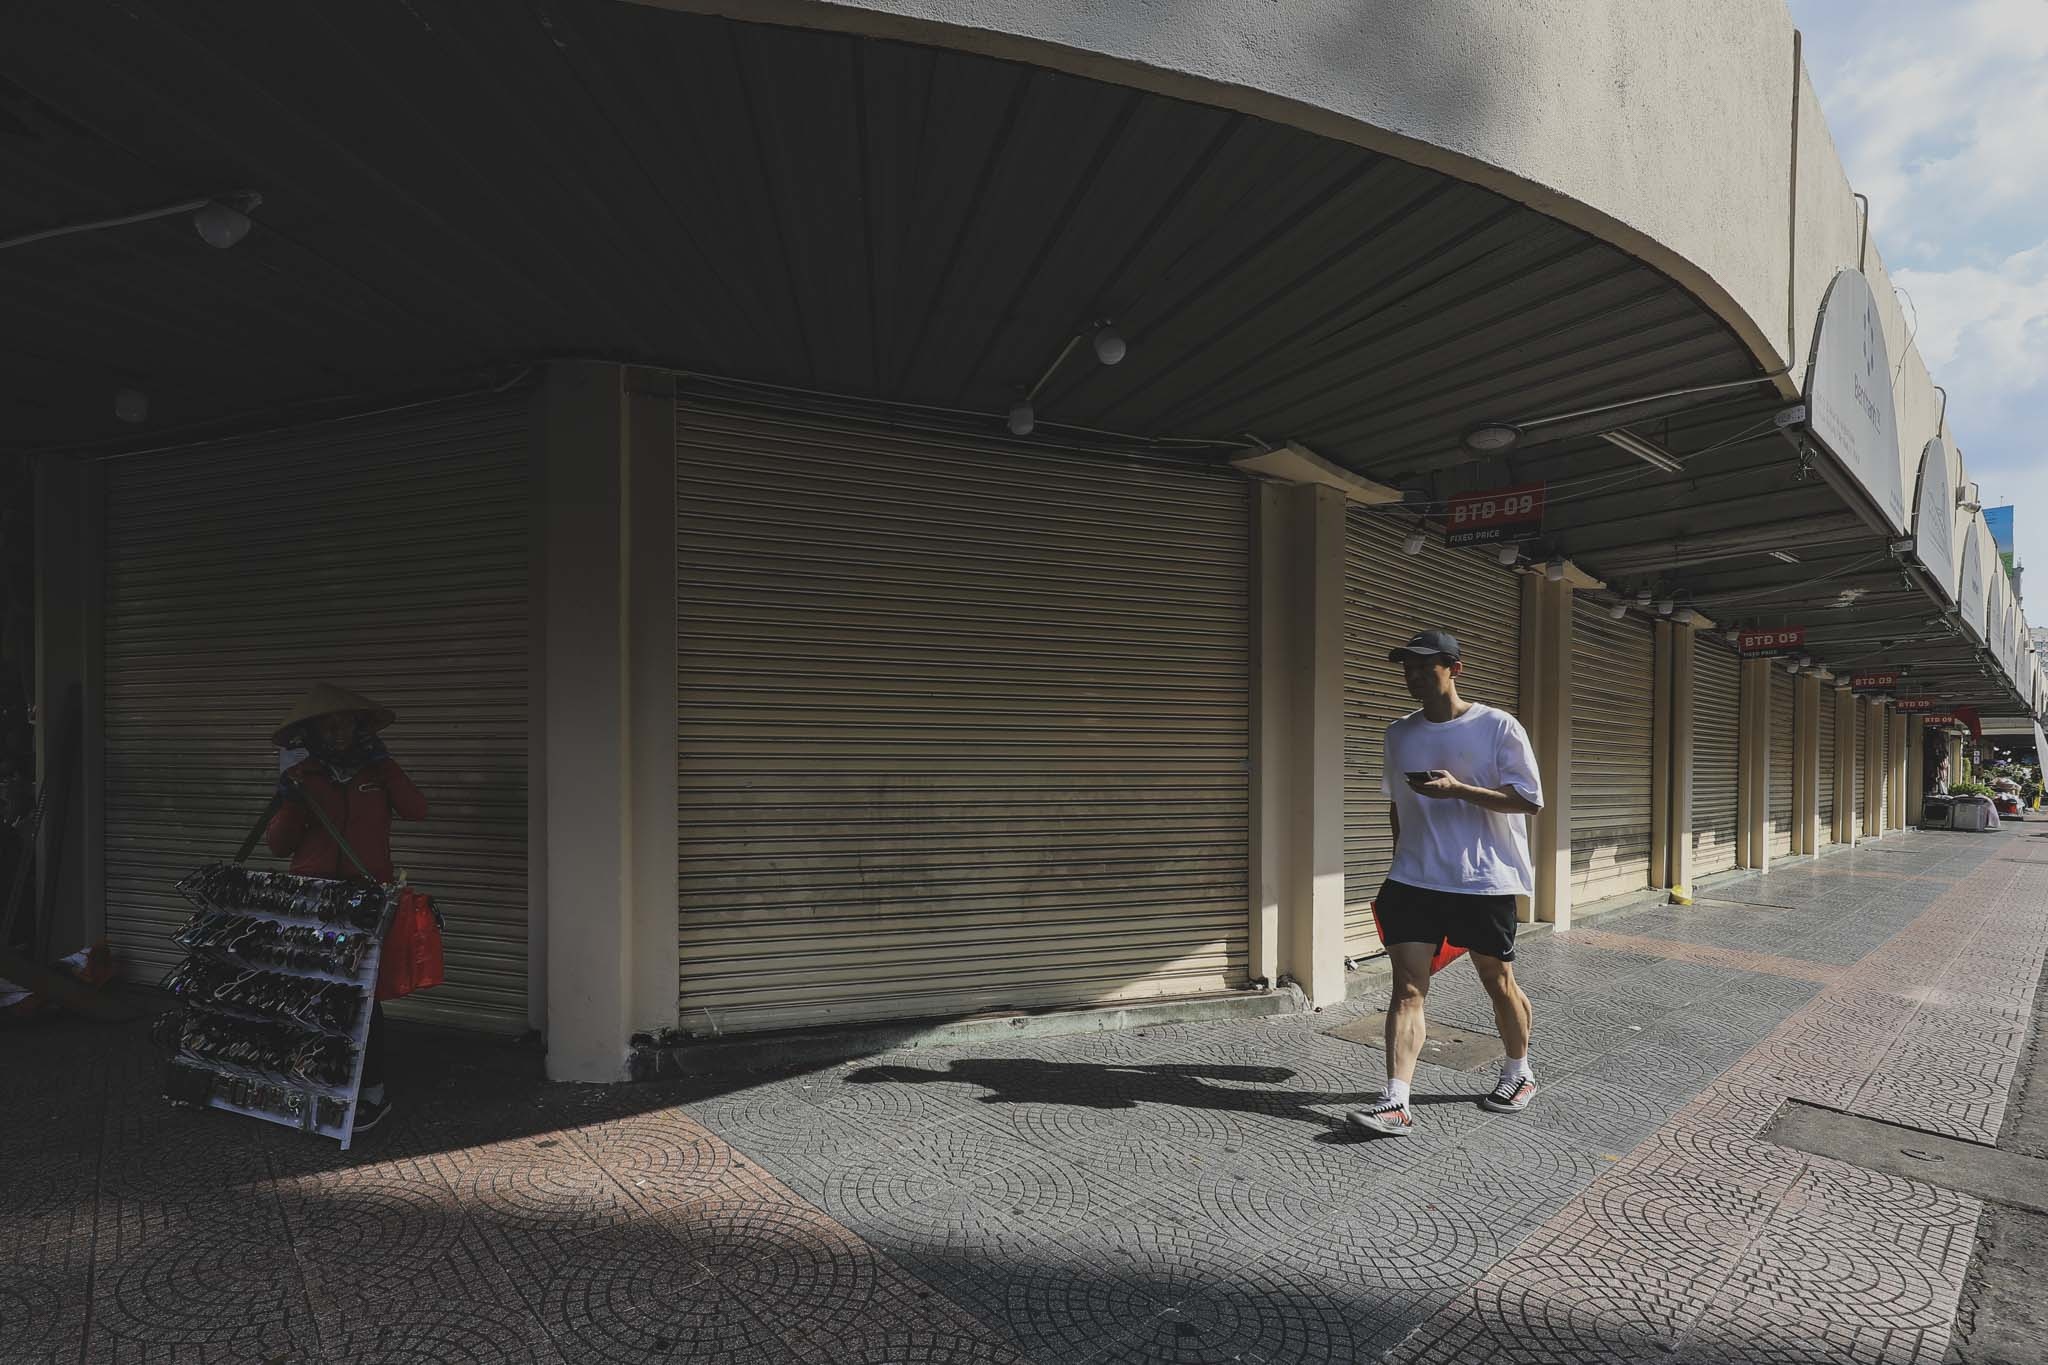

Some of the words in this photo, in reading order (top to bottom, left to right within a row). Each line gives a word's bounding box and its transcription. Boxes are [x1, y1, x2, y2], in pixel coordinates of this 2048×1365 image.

[1504, 495, 1533, 515] 09
[1450, 533, 1474, 542] FIXED
[1475, 529, 1501, 540] PRICE
[1778, 633, 1798, 643] 09
[1878, 676, 1892, 684] 09
